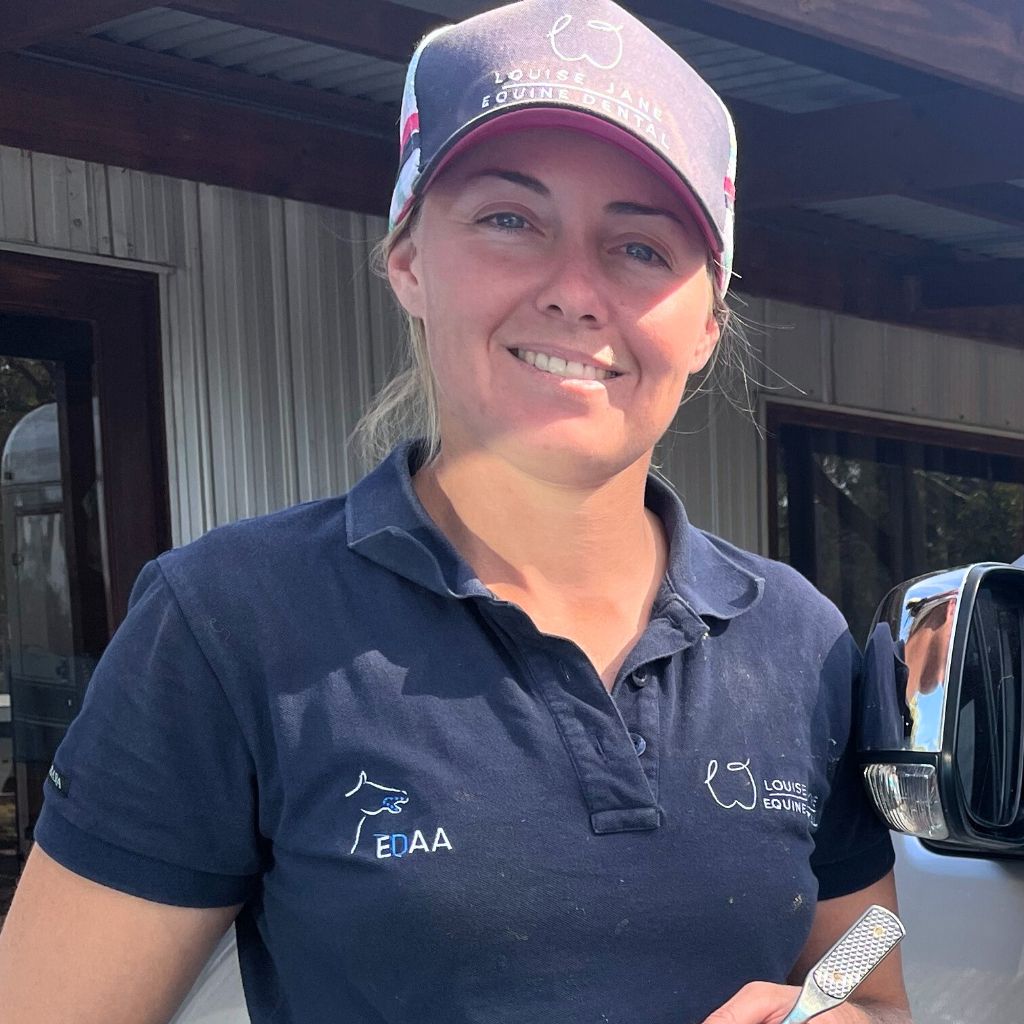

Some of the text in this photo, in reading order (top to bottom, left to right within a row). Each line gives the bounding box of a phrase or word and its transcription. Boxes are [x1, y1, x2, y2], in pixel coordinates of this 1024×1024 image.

[494, 68, 663, 122] LOUISE JANE
[481, 87, 670, 150] EQUINE DENTAL
[763, 779, 807, 796] LOUISE
[763, 797, 807, 815] EQUINE
[376, 826, 453, 859] EDAA
